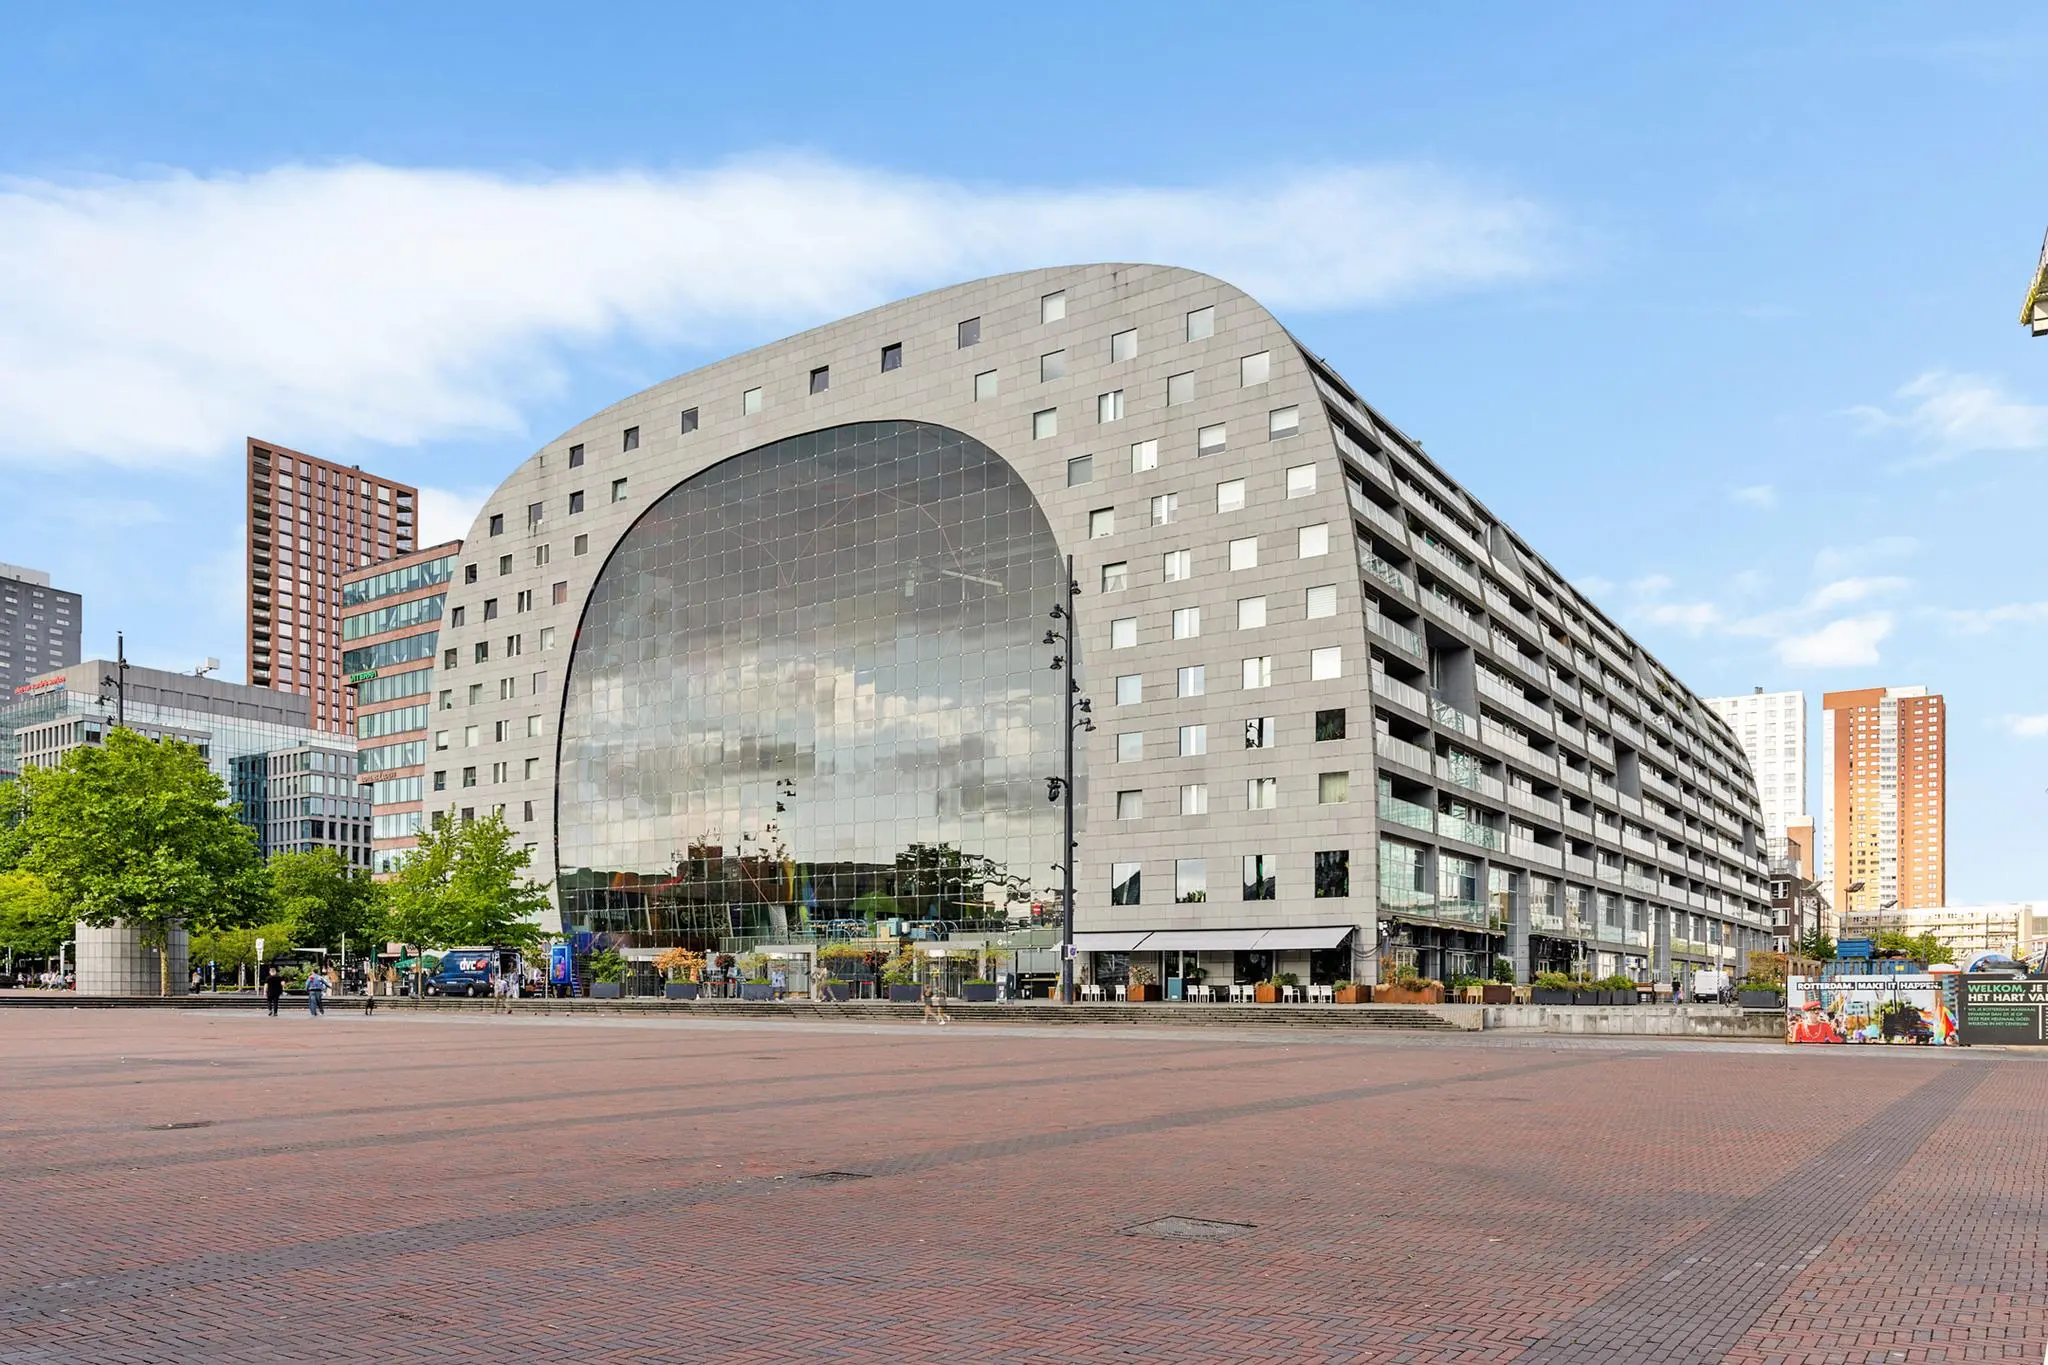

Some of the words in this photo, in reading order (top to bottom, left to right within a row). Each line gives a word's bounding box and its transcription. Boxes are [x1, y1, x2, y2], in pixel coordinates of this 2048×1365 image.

[1797, 982, 1854, 990] ROTTERDAM.
[1858, 982, 1884, 990] MAKE
[1900, 981, 1942, 989] HAPPEN.
[1967, 984, 2026, 994] WELKOM,
[2030, 984, 2043, 993] JE
[1968, 993, 1990, 1002] HET
[1993, 993, 2025, 1002] HART
